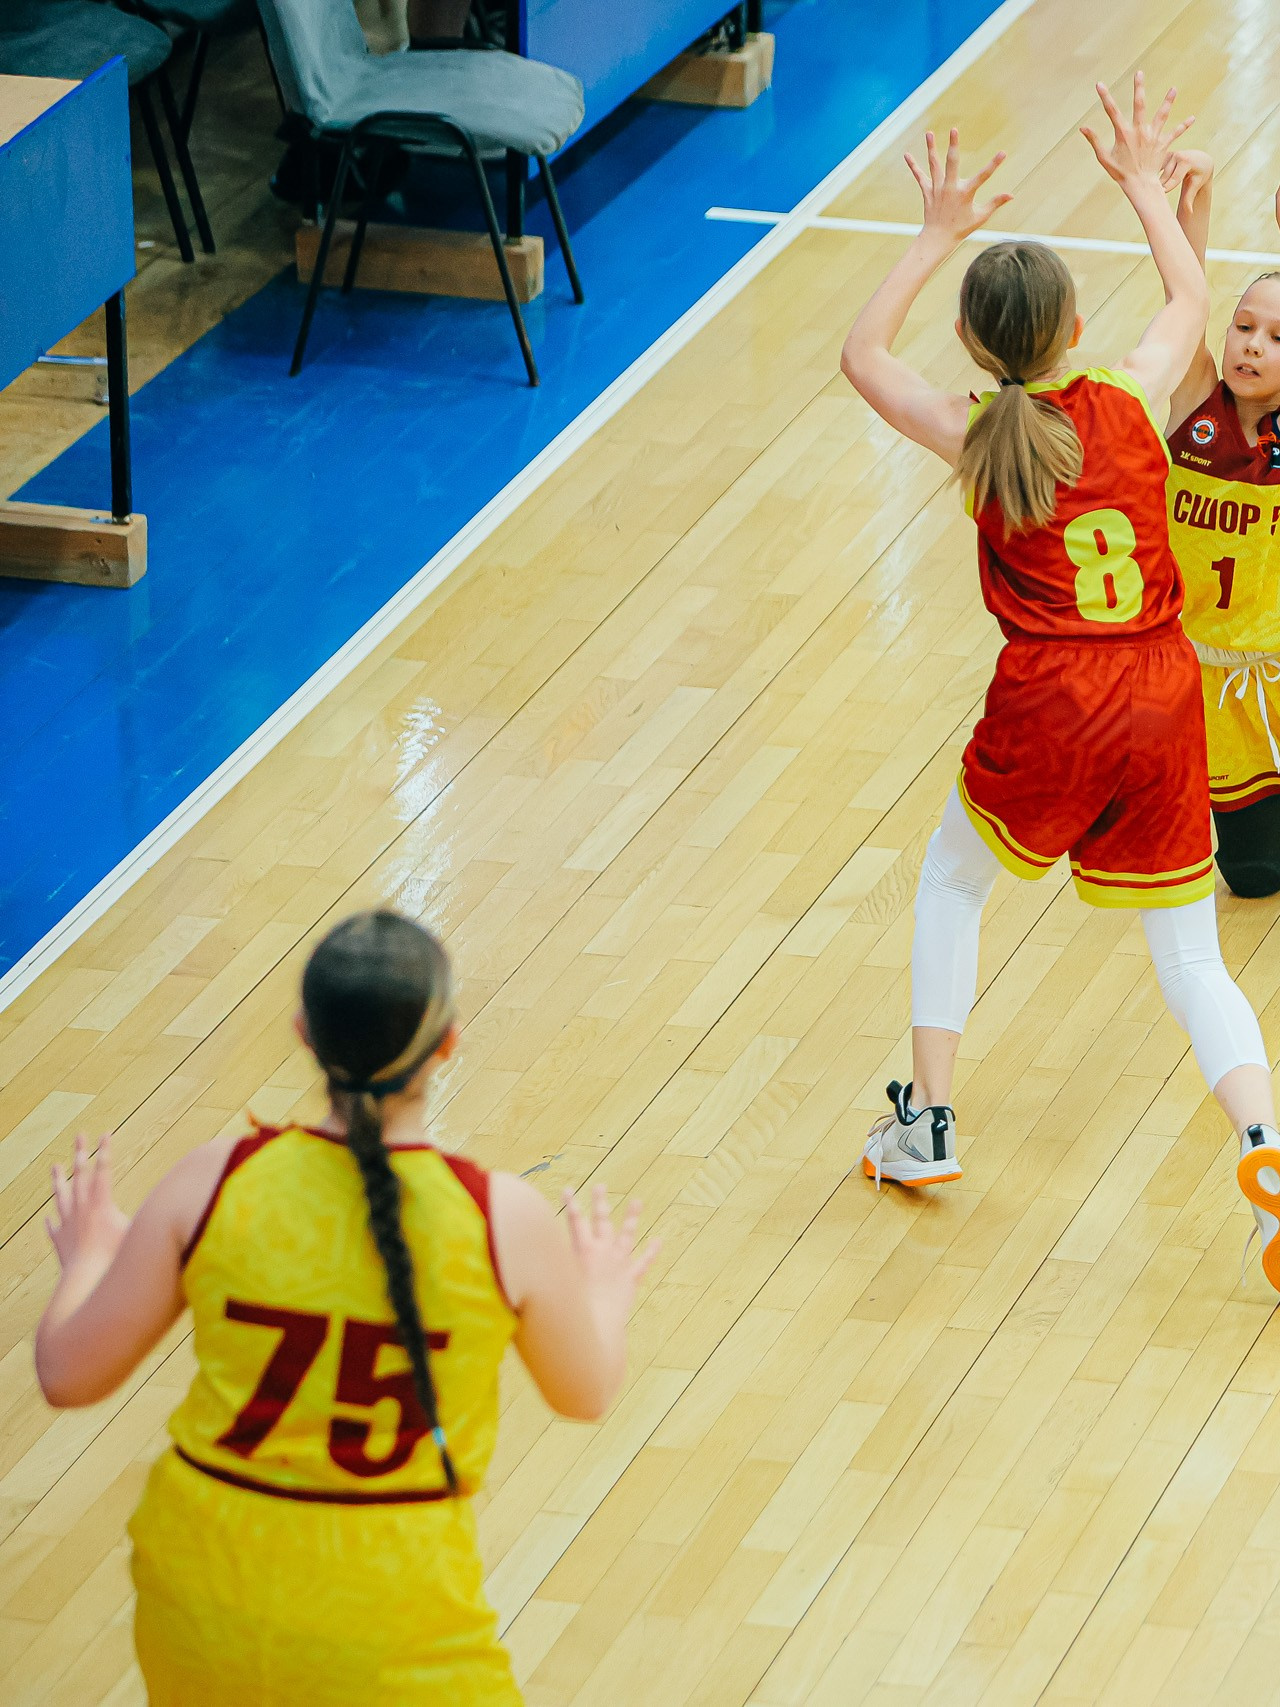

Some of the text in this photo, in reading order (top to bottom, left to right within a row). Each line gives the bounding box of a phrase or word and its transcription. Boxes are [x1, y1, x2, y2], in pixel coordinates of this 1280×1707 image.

[1190, 455, 1212, 467] SPORT
[1174, 489, 1260, 536] СШОР
[1064, 508, 1144, 623] 8
[1211, 556, 1236, 610] 1
[214, 1300, 450, 1478] 75
